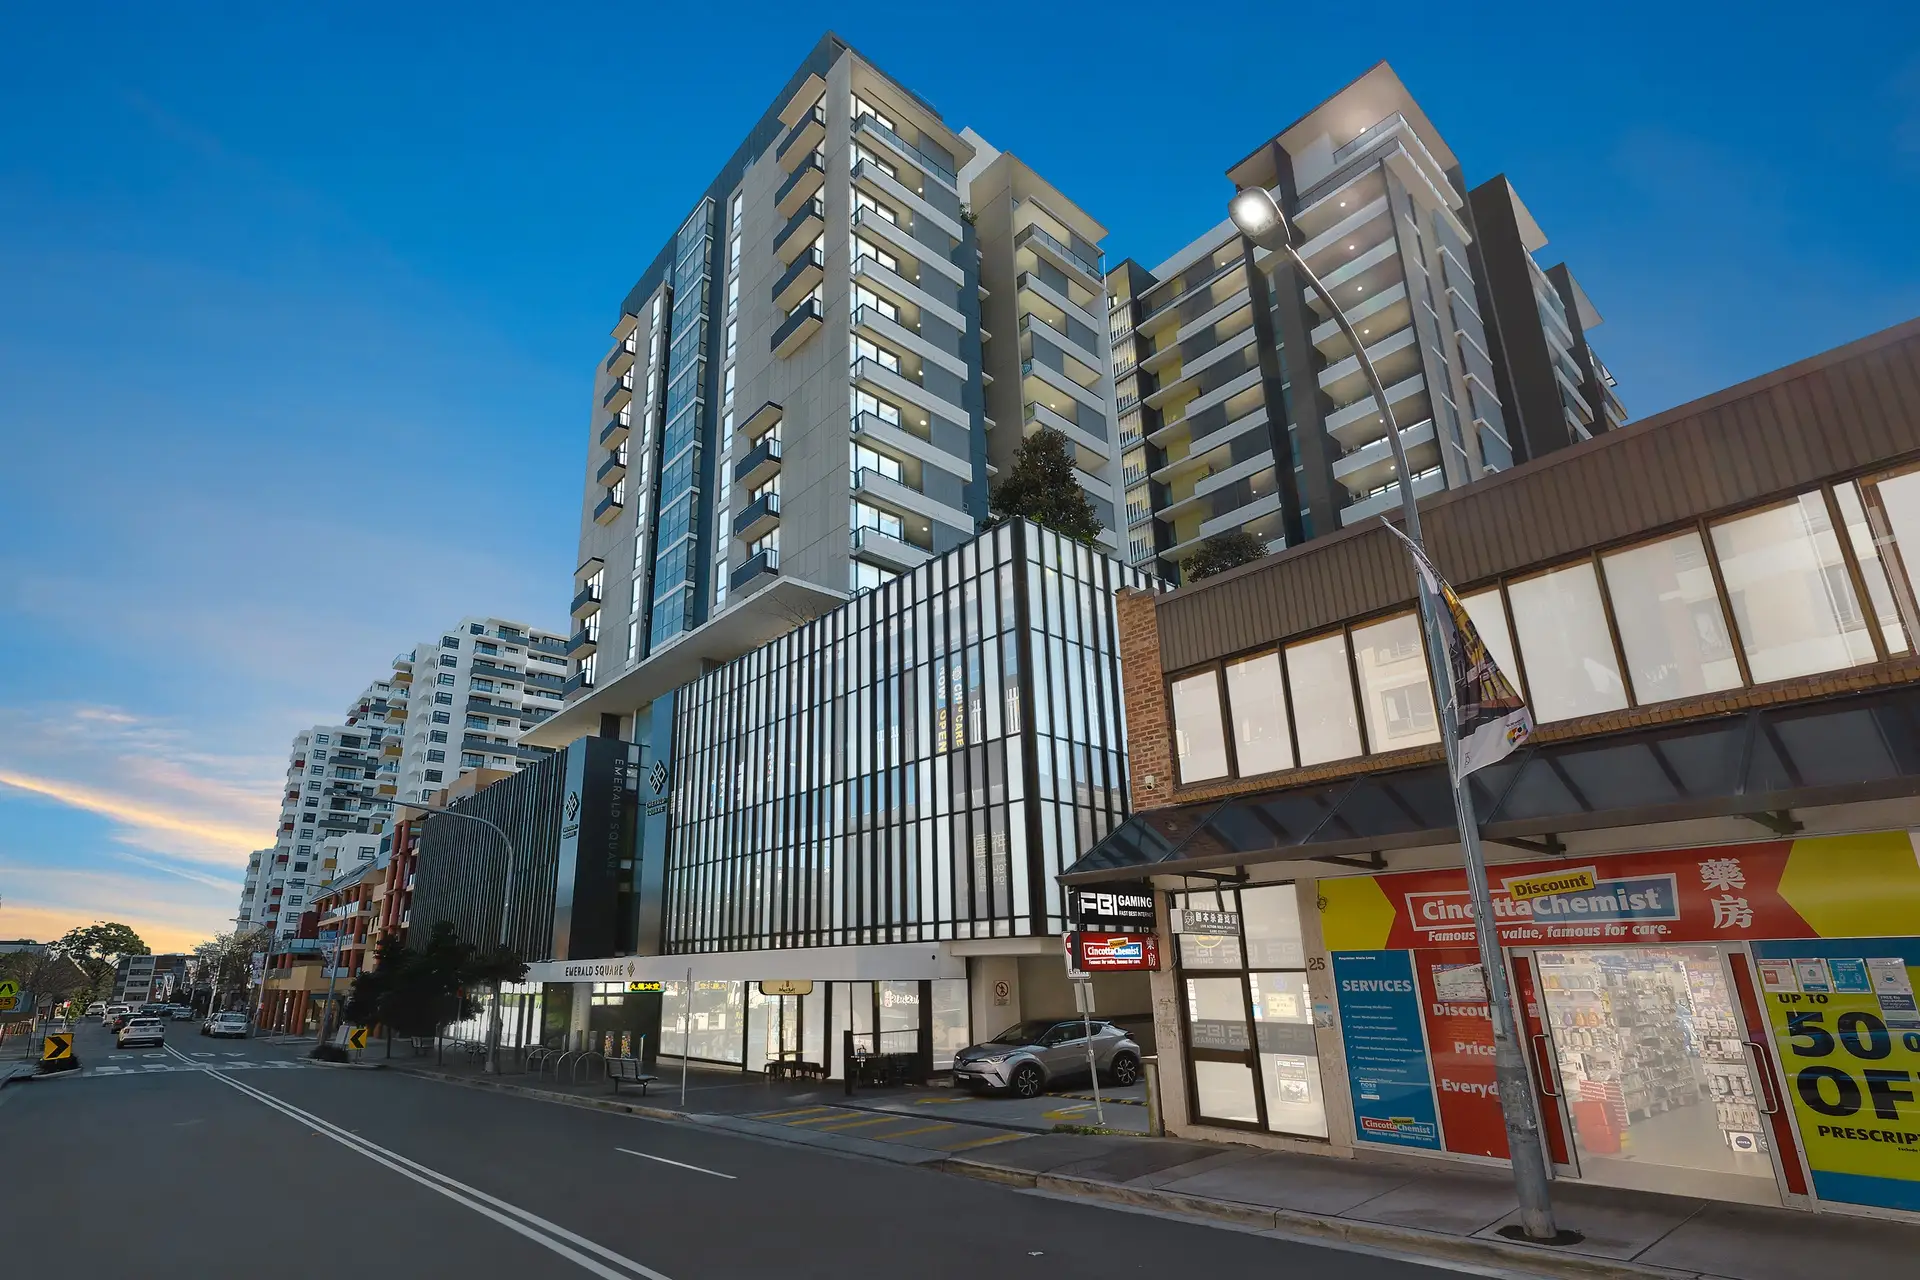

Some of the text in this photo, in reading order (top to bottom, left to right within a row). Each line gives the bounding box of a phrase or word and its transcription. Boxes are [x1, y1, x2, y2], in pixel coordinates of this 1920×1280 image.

[938, 709, 948, 752] OPEN
[611, 758, 624, 818] EMERALD
[1513, 875, 1589, 896] Discount
[1697, 857, 1754, 929] 藥房
[1080, 892, 1153, 916] FBI GAMING
[1422, 888, 1659, 920] CincttaChemist
[1428, 930, 1475, 942] Famous
[1501, 927, 1543, 941] value,
[1547, 925, 1601, 938] famous
[1604, 923, 1629, 936] for
[1633, 923, 1672, 936] care.
[1087, 945, 1140, 956] CincottaChemist
[565, 964, 624, 977] EMERALD SQUARE
[1308, 957, 1326, 970] 25
[1341, 979, 1413, 992] SERVICES
[1777, 993, 1829, 1004] UP TO
[1432, 1003, 1491, 1020] Discou
[1454, 1041, 1497, 1057] Price
[1441, 1078, 1500, 1098] Everyd
[1796, 1065, 1920, 1120] OF
[1365, 1119, 1431, 1134] CincottaChemist
